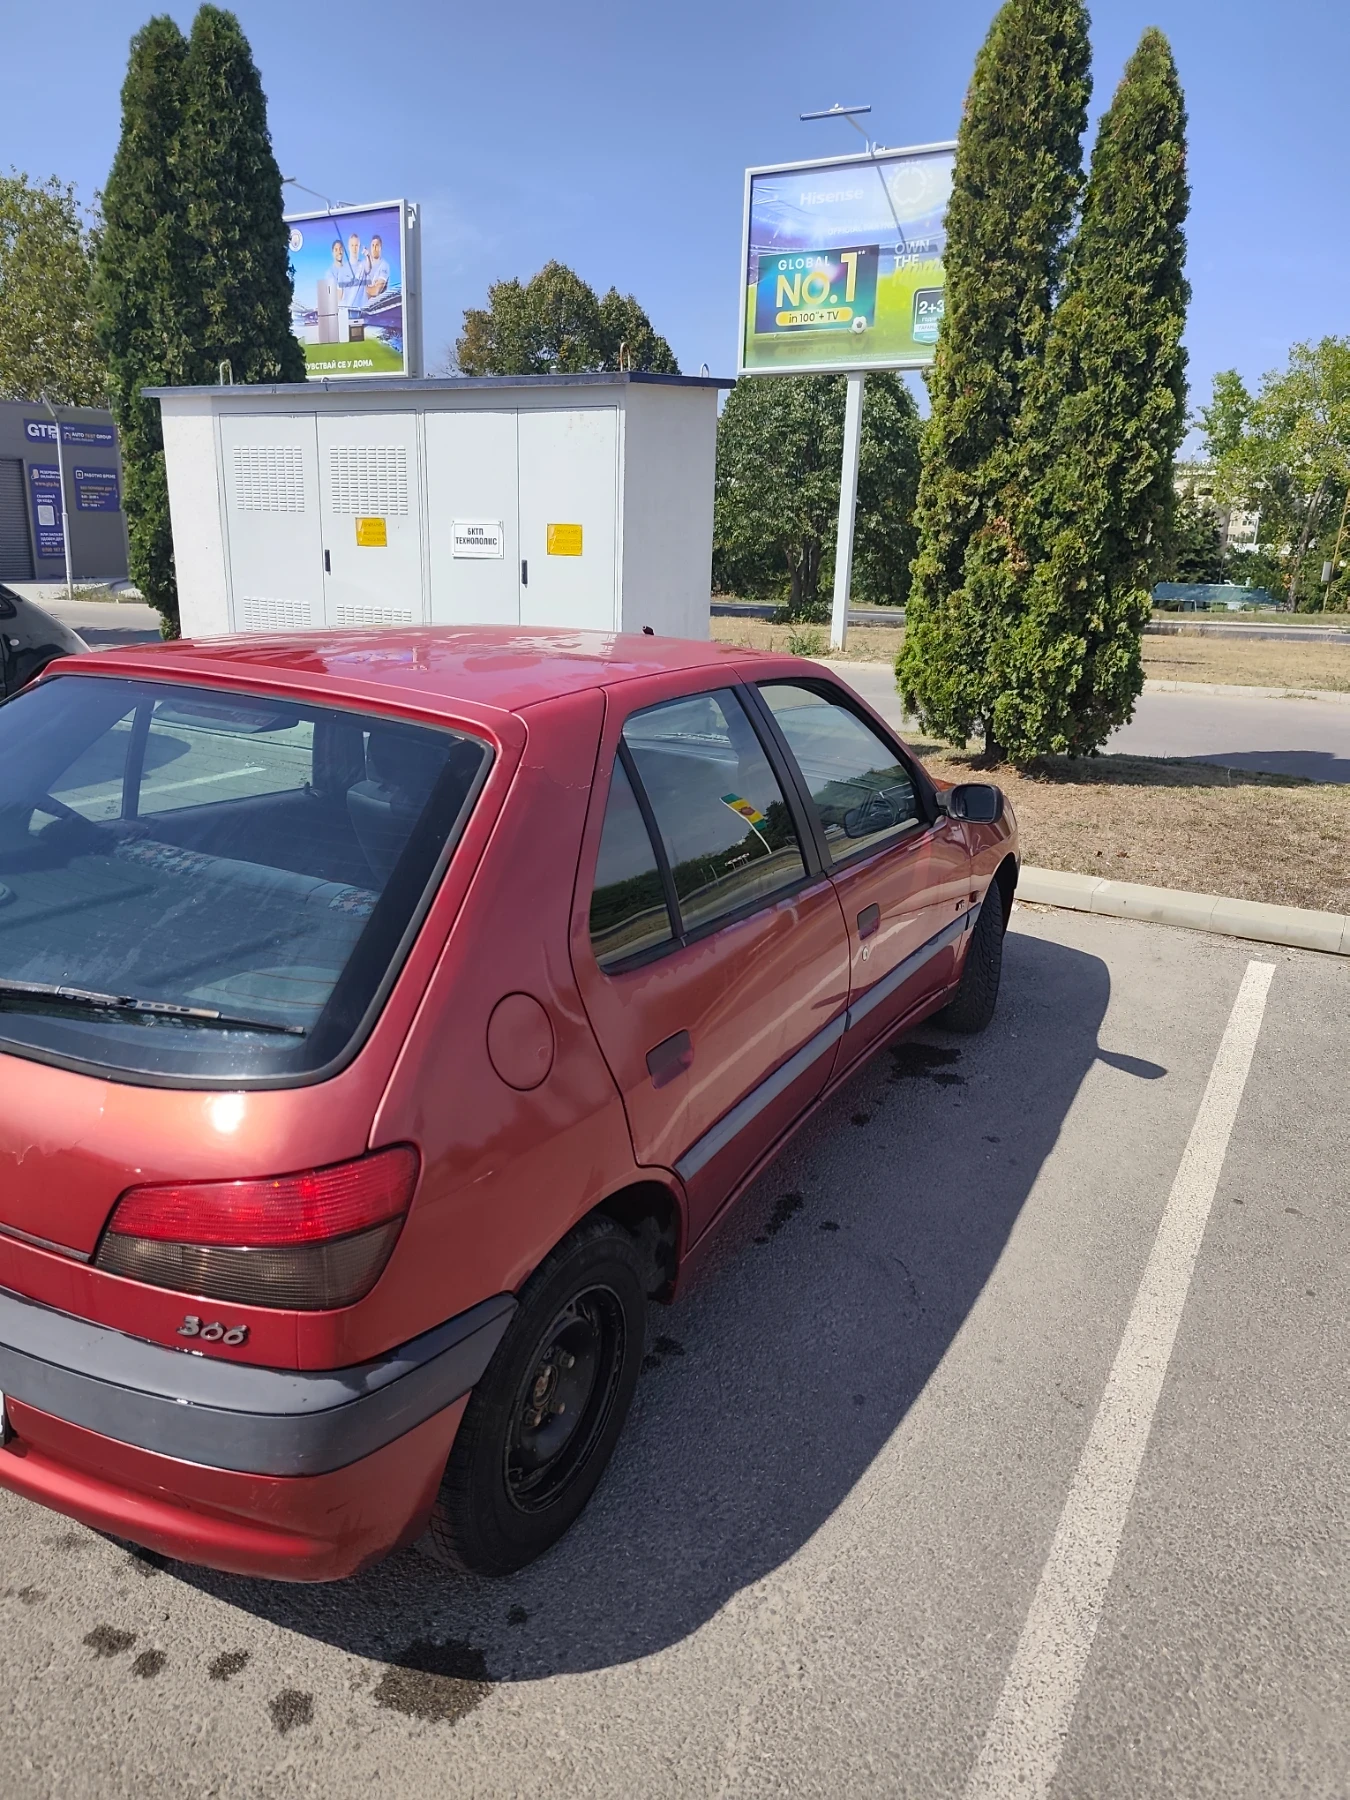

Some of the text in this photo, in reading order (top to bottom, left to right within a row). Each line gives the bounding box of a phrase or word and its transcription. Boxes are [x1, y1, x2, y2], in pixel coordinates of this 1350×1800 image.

[799, 188, 865, 206] Hisense
[894, 240, 930, 255] OWN
[777, 255, 831, 272] GLOBAL
[893, 254, 920, 268] THE
[788, 314, 798, 324] in
[826, 310, 841, 321] TV
[337, 360, 347, 369] СЕ
[347, 360, 353, 368] У
[353, 359, 374, 369] ДОМА
[467, 527, 484, 536] БКТП
[455, 536, 498, 545] ТЕХНОПОЛИС
[177, 1315, 247, 1345] 306
